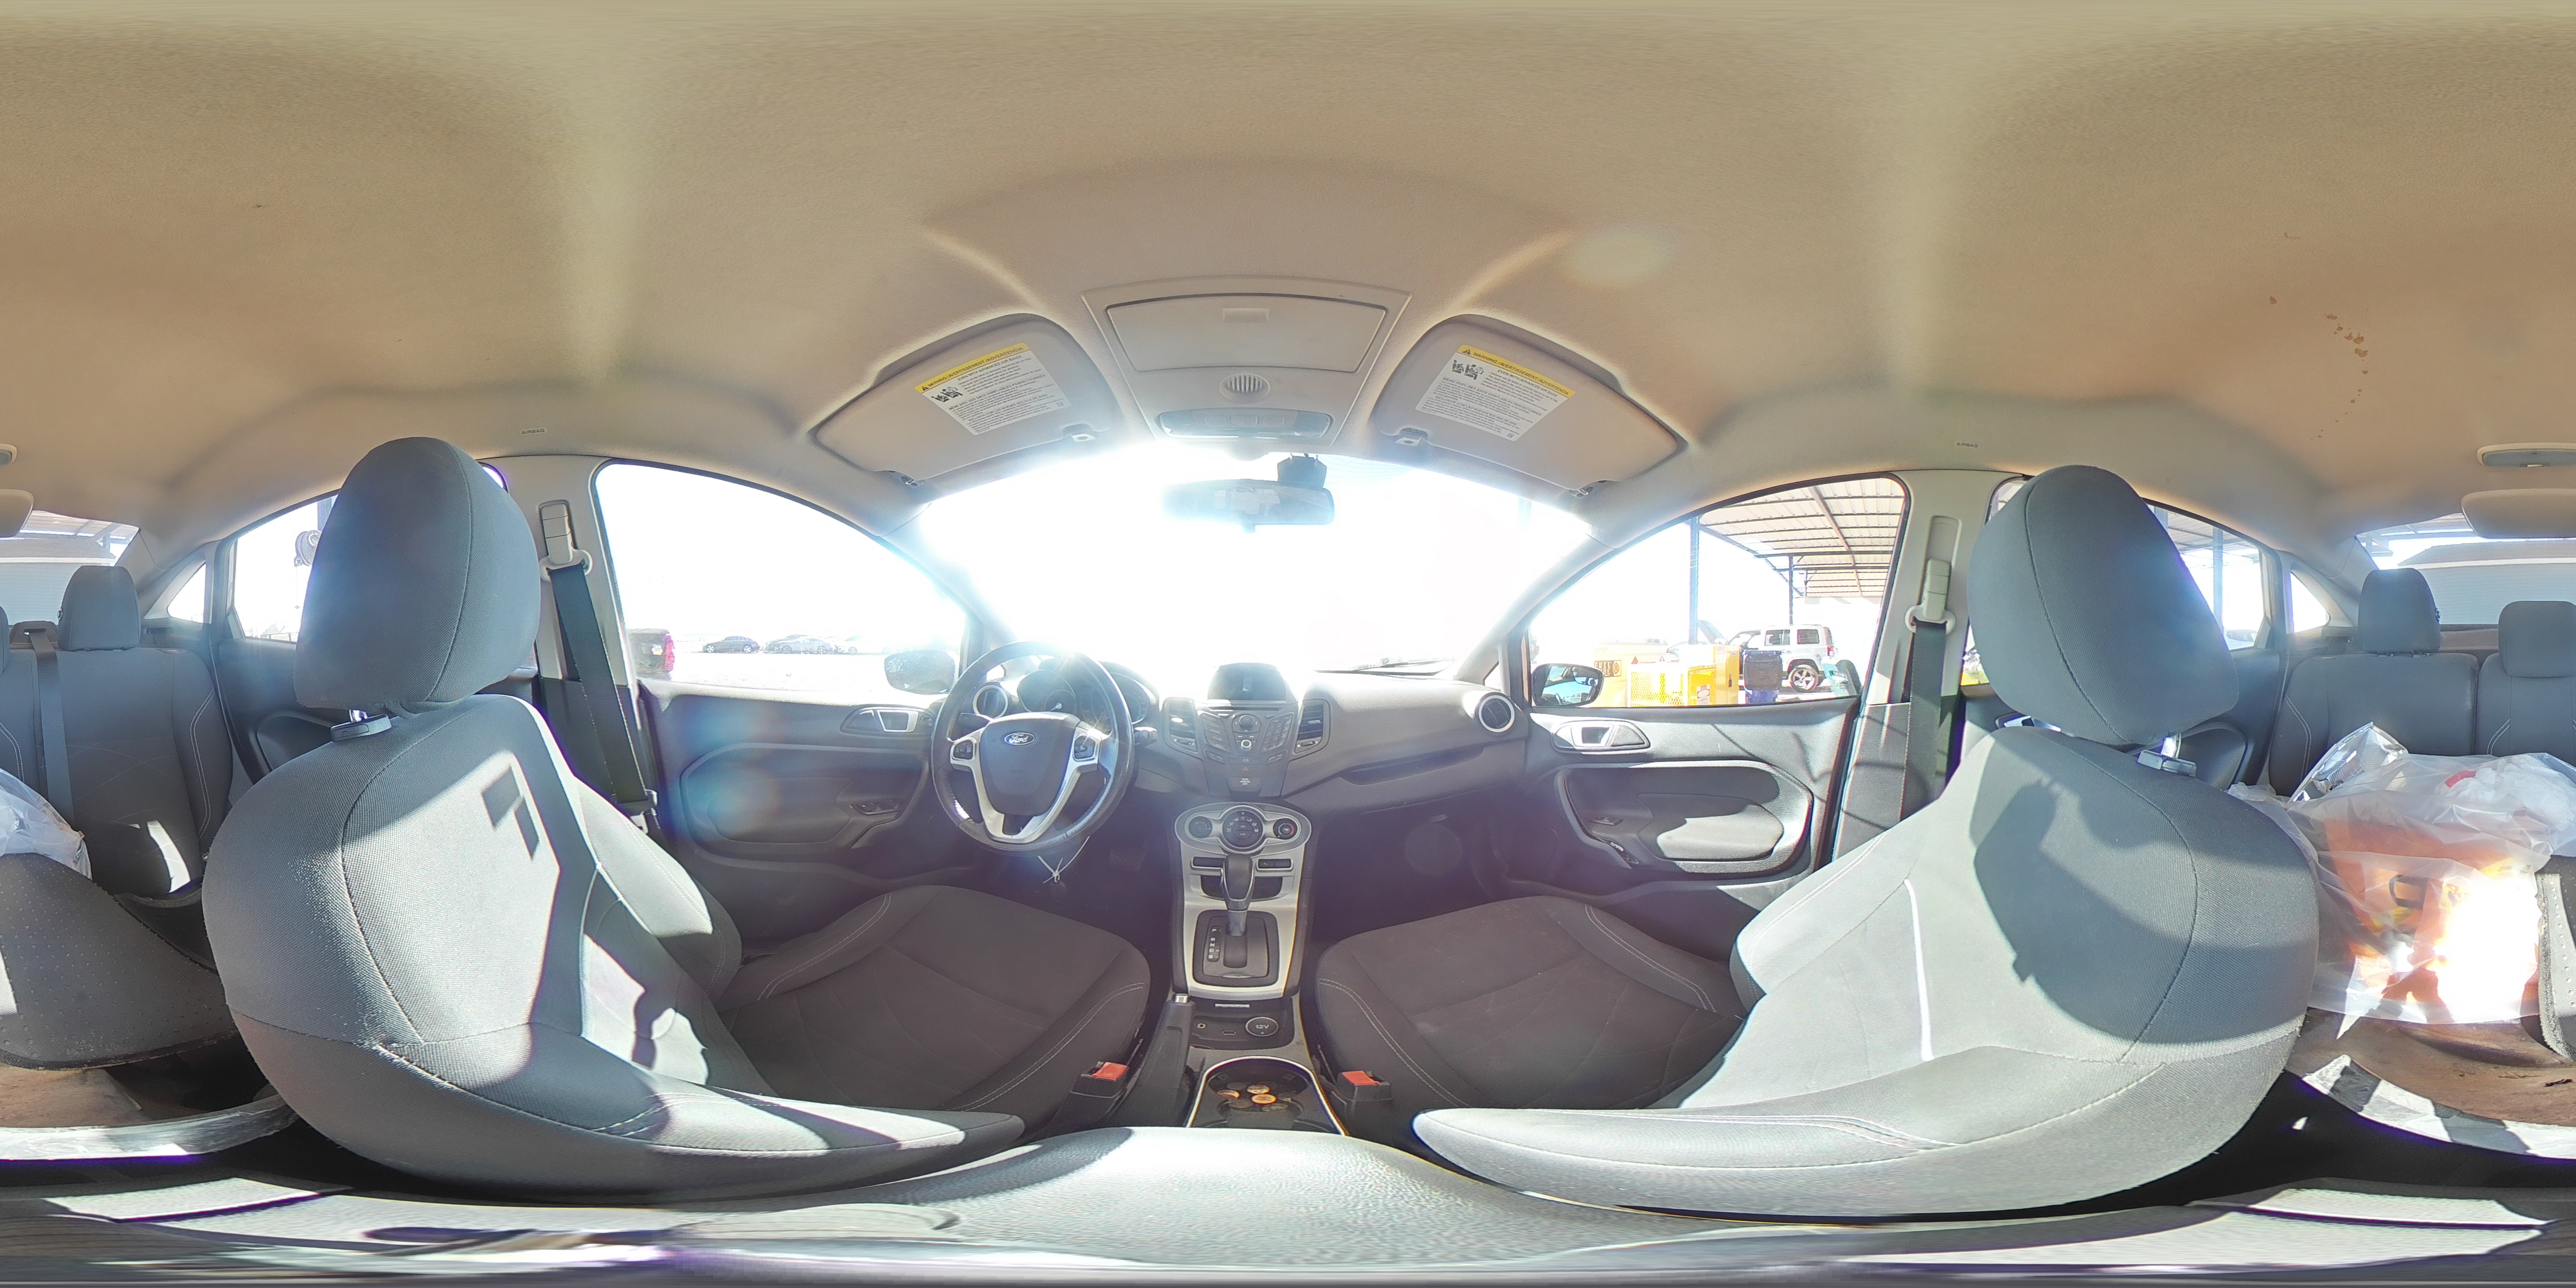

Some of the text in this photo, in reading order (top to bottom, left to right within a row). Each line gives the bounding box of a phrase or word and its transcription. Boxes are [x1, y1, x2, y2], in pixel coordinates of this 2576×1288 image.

[1473, 352, 1498, 363] WARNING
[978, 362, 1001, 372] ADVANCED
[927, 377, 947, 387] WARNING
[1520, 378, 1541, 389] ADVANCED
[1009, 734, 1029, 743] Ford
